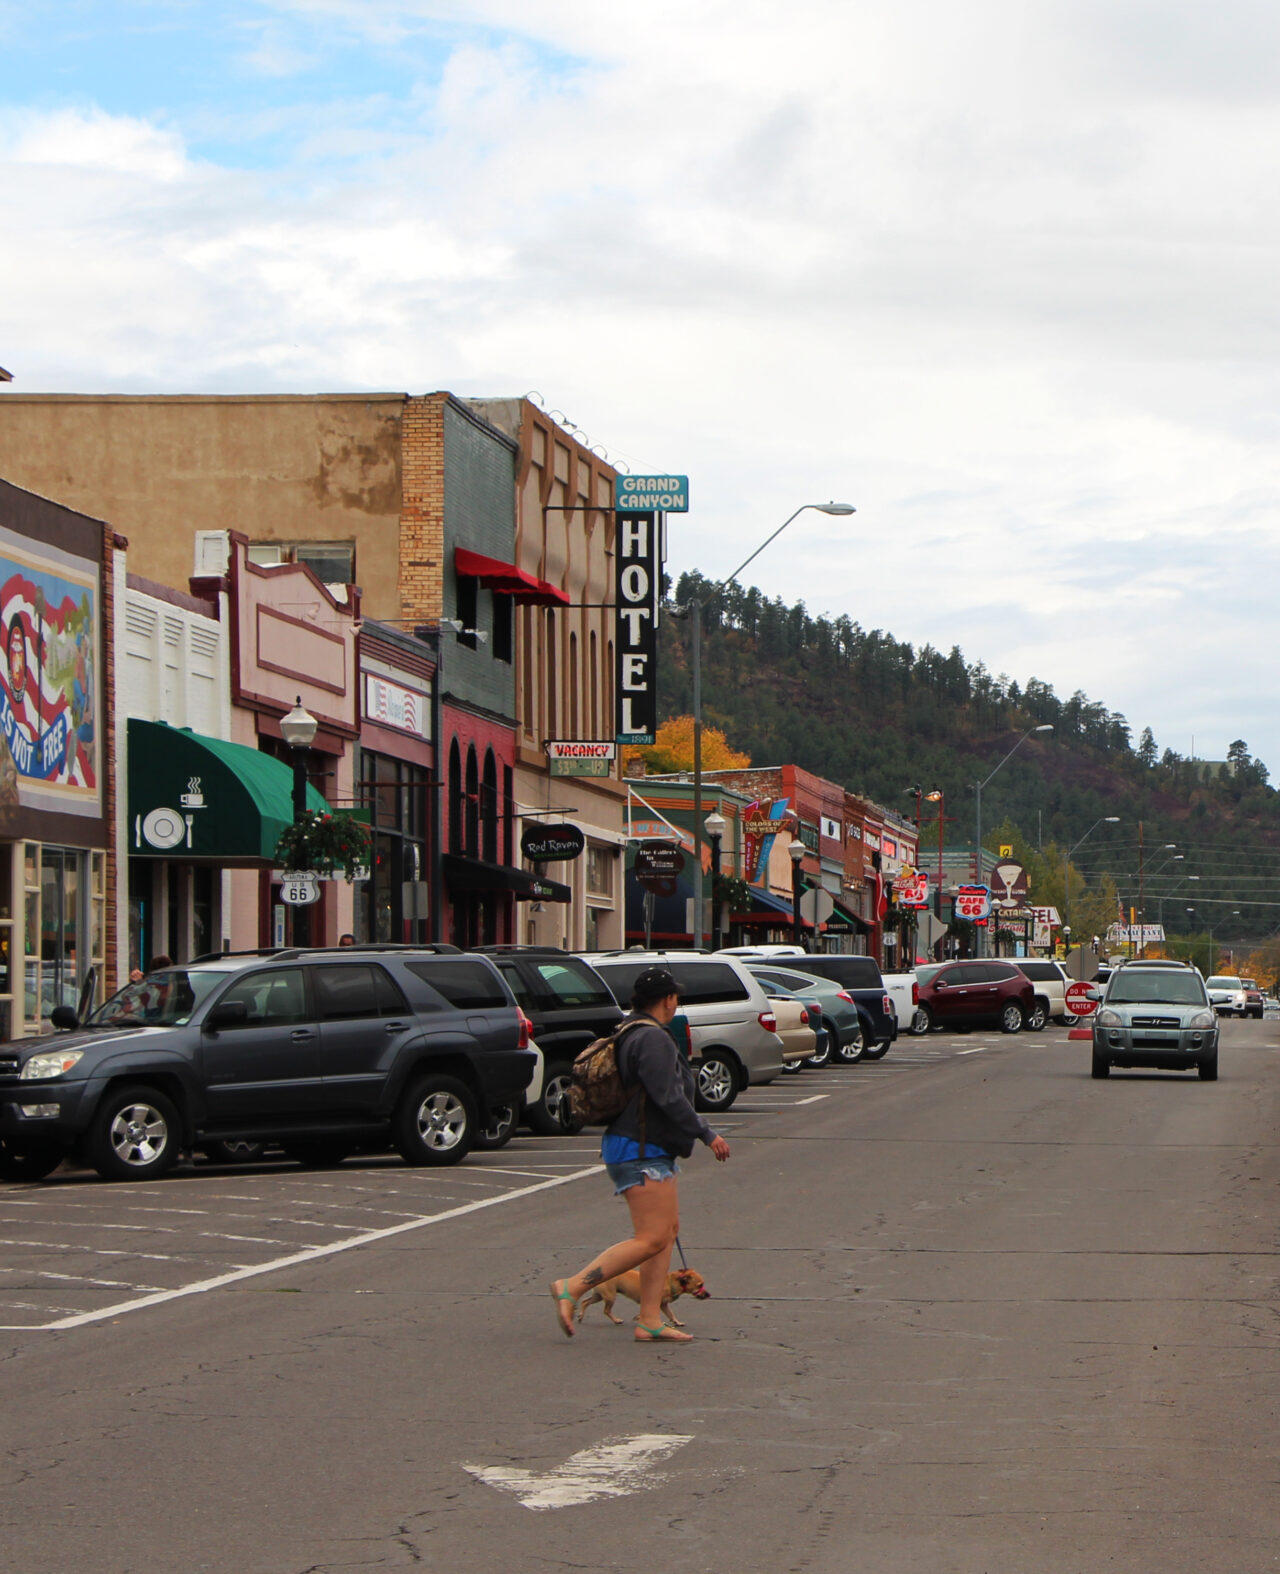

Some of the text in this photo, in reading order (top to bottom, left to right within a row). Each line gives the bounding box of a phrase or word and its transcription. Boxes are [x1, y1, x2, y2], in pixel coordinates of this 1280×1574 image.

[622, 477, 680, 491] GRAND
[619, 494, 684, 508] CANYON
[620, 520, 650, 734] HOTEL
[1, 694, 64, 774] IS NOT FREE
[555, 745, 610, 757] VACANCY
[527, 839, 579, 853] Red Raven
[290, 888, 307, 901] 66
[961, 904, 982, 916] 66
